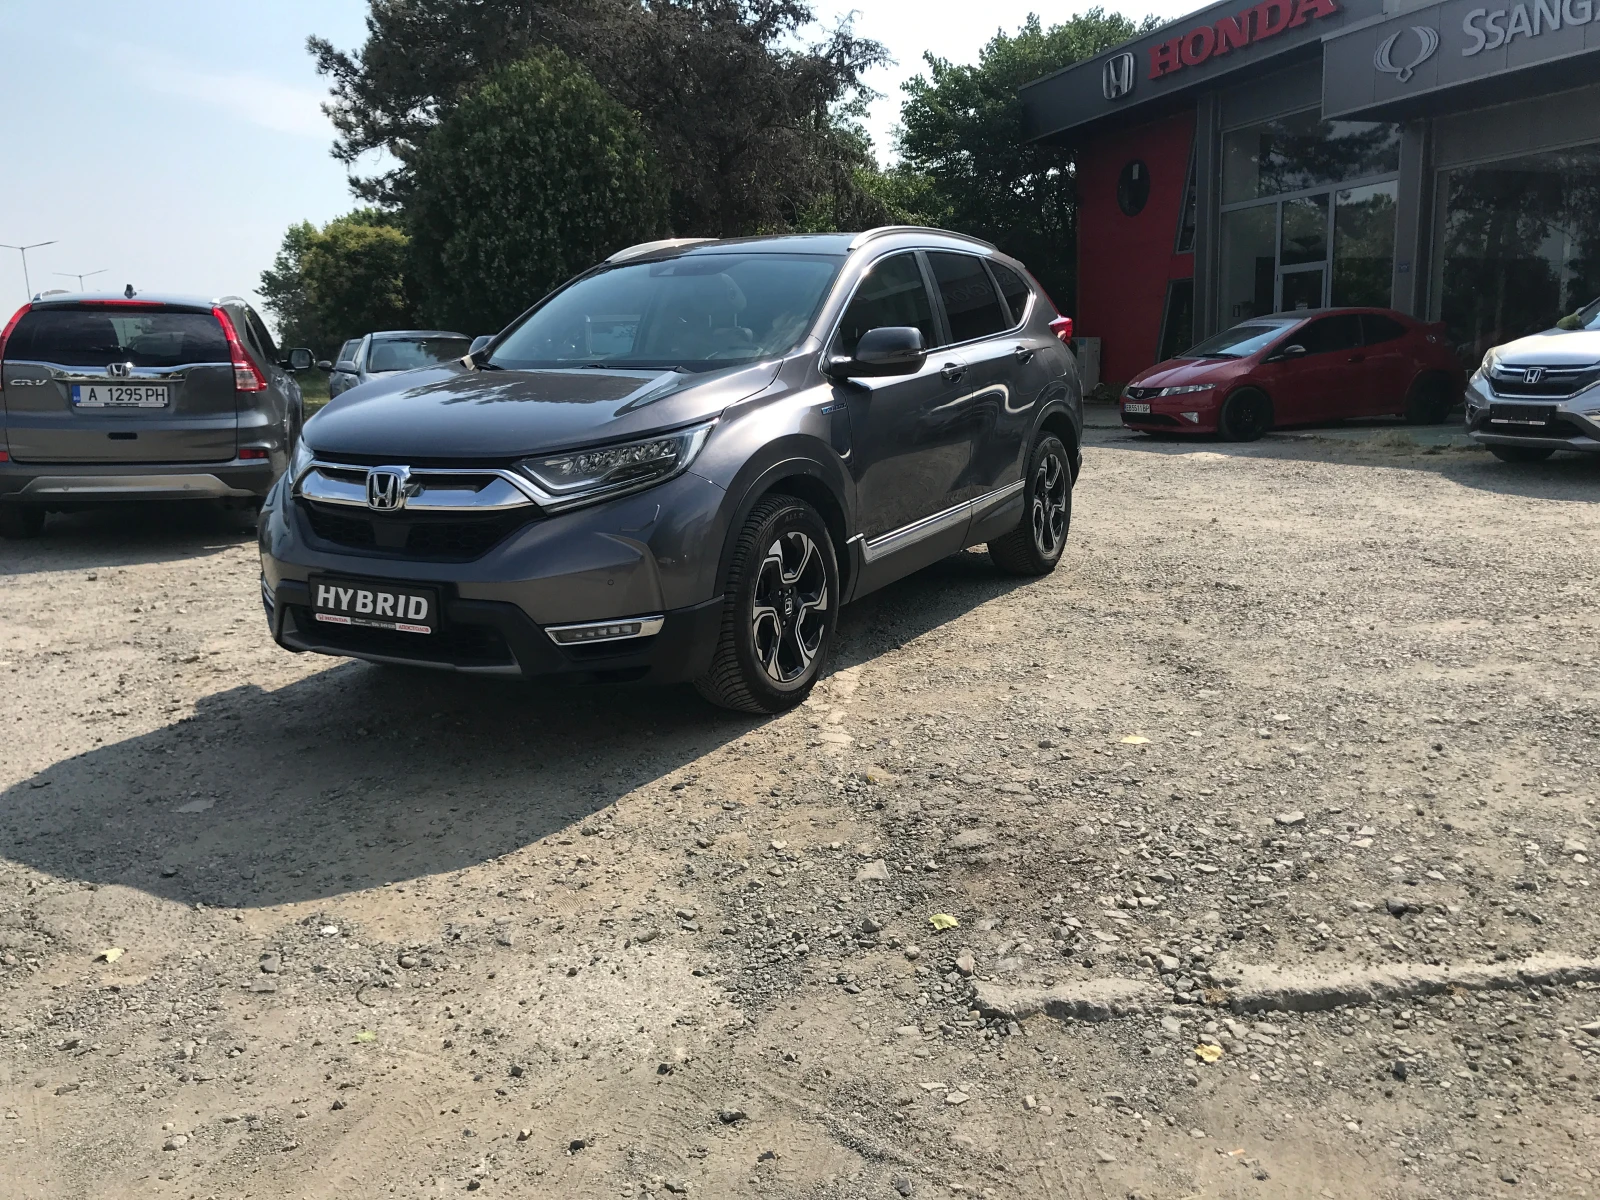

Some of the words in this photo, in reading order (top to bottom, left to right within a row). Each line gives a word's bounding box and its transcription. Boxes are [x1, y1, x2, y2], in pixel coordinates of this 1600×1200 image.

[1148, 0, 1337, 79] HONDA
[1461, 0, 1600, 57] SSANG
[88, 388, 98, 401] A
[107, 388, 142, 402] 1295
[317, 584, 428, 620] HYBRID
